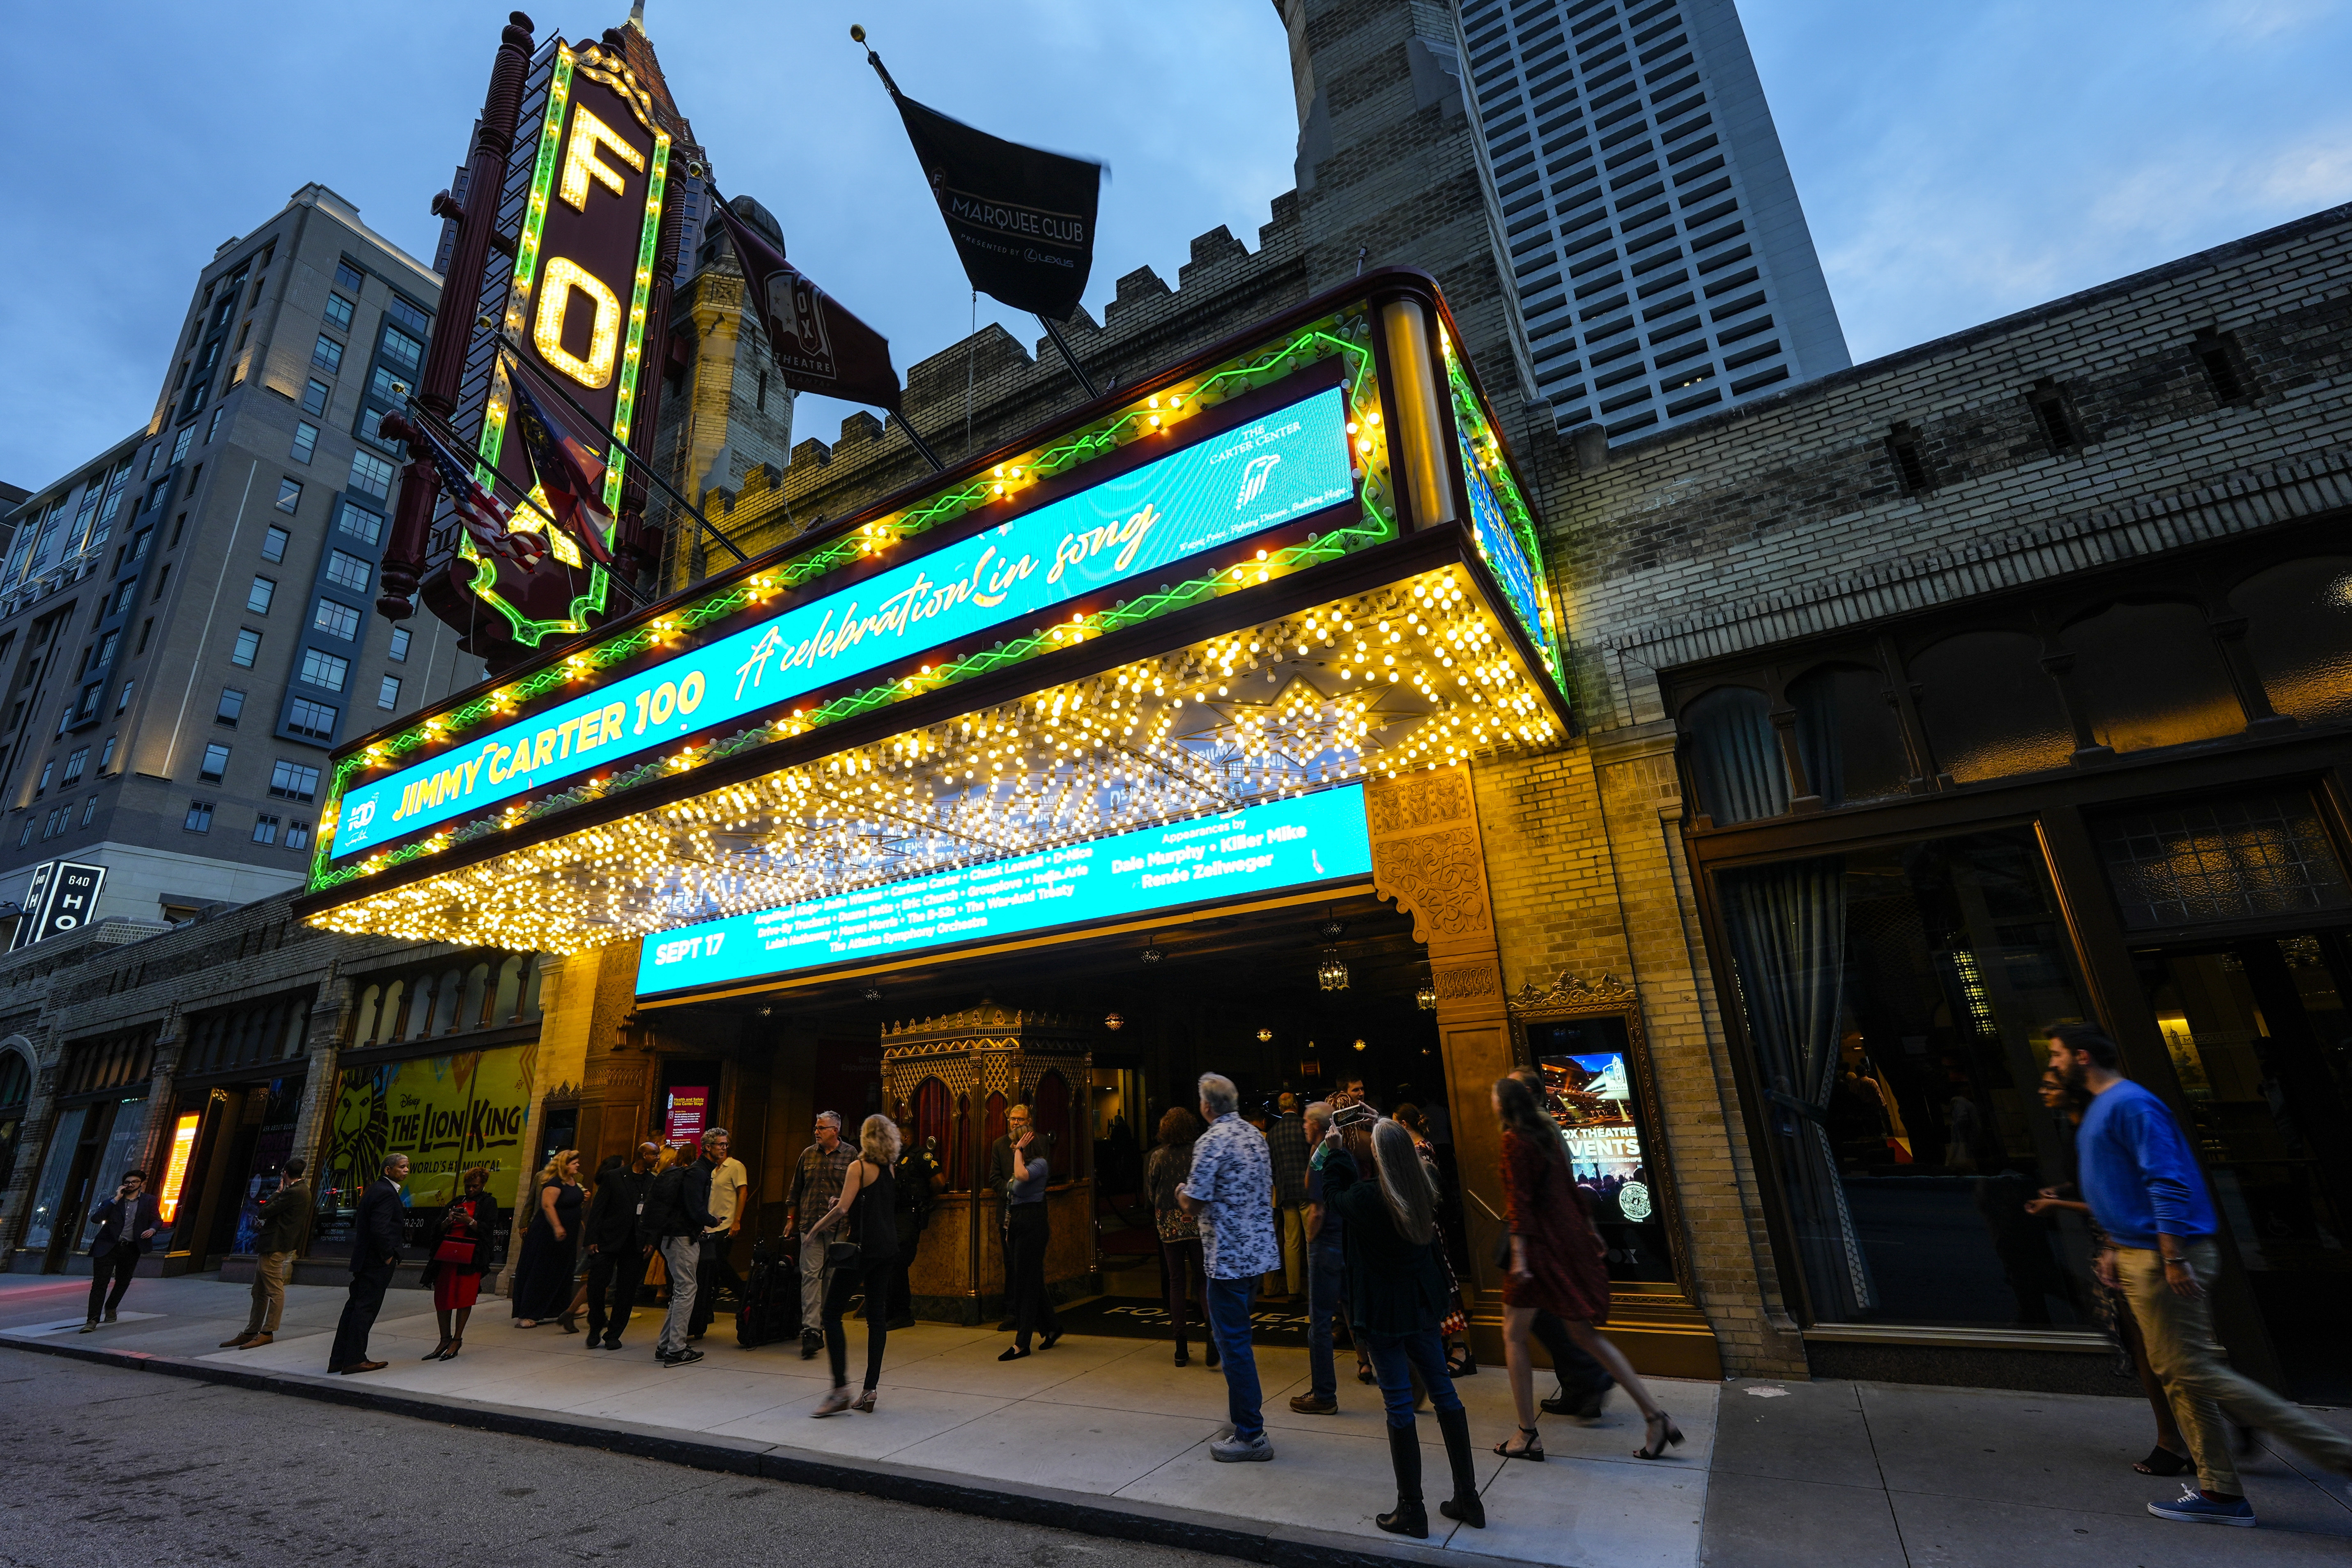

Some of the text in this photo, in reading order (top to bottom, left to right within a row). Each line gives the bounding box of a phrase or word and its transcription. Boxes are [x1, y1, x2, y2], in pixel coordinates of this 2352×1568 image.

[952, 196, 1083, 242] MARQUEE CLUB
[961, 233, 1007, 254] PRESENTED
[1038, 253, 1074, 268] LEXUS
[775, 352, 830, 372] THEATRE
[1210, 421, 1301, 465] CARTER CENTER
[1243, 424, 1265, 440] THE
[736, 621, 779, 701] A
[779, 572, 969, 669] celebration
[1046, 503, 1160, 583] song
[392, 670, 706, 822] JIMMY CARTER 100
[1161, 818, 1246, 844] Appearances by
[1111, 825, 1308, 874] Dale Murphy Killer Mike
[36, 874, 46, 885] 640
[68, 875, 90, 887] 640
[929, 874, 961, 889] Carter
[969, 864, 1003, 881] Chuck
[1053, 847, 1093, 864] D-Nice
[1141, 853, 1274, 889] Renée Zellweger
[757, 923, 793, 938] Drive-By
[794, 916, 831, 931] Truckers
[838, 909, 867, 922] Duane
[901, 897, 922, 910] Eric
[922, 889, 959, 906] Church
[967, 878, 1023, 897] Grouplove
[907, 911, 926, 924] The
[927, 906, 956, 921] B-52s
[964, 901, 985, 914] The
[829, 916, 988, 953] The Atlanta Symphony Orchestra
[654, 932, 726, 966] SEPT 17
[391, 1098, 521, 1153] THE LION KING
[1561, 1127, 1637, 1140] OX THEATRE
[1566, 1138, 1641, 1157] VENTS
[409, 1160, 501, 1174] WORLD'S #1 MUSICAL
[409, 1218, 424, 1228] 2-20
